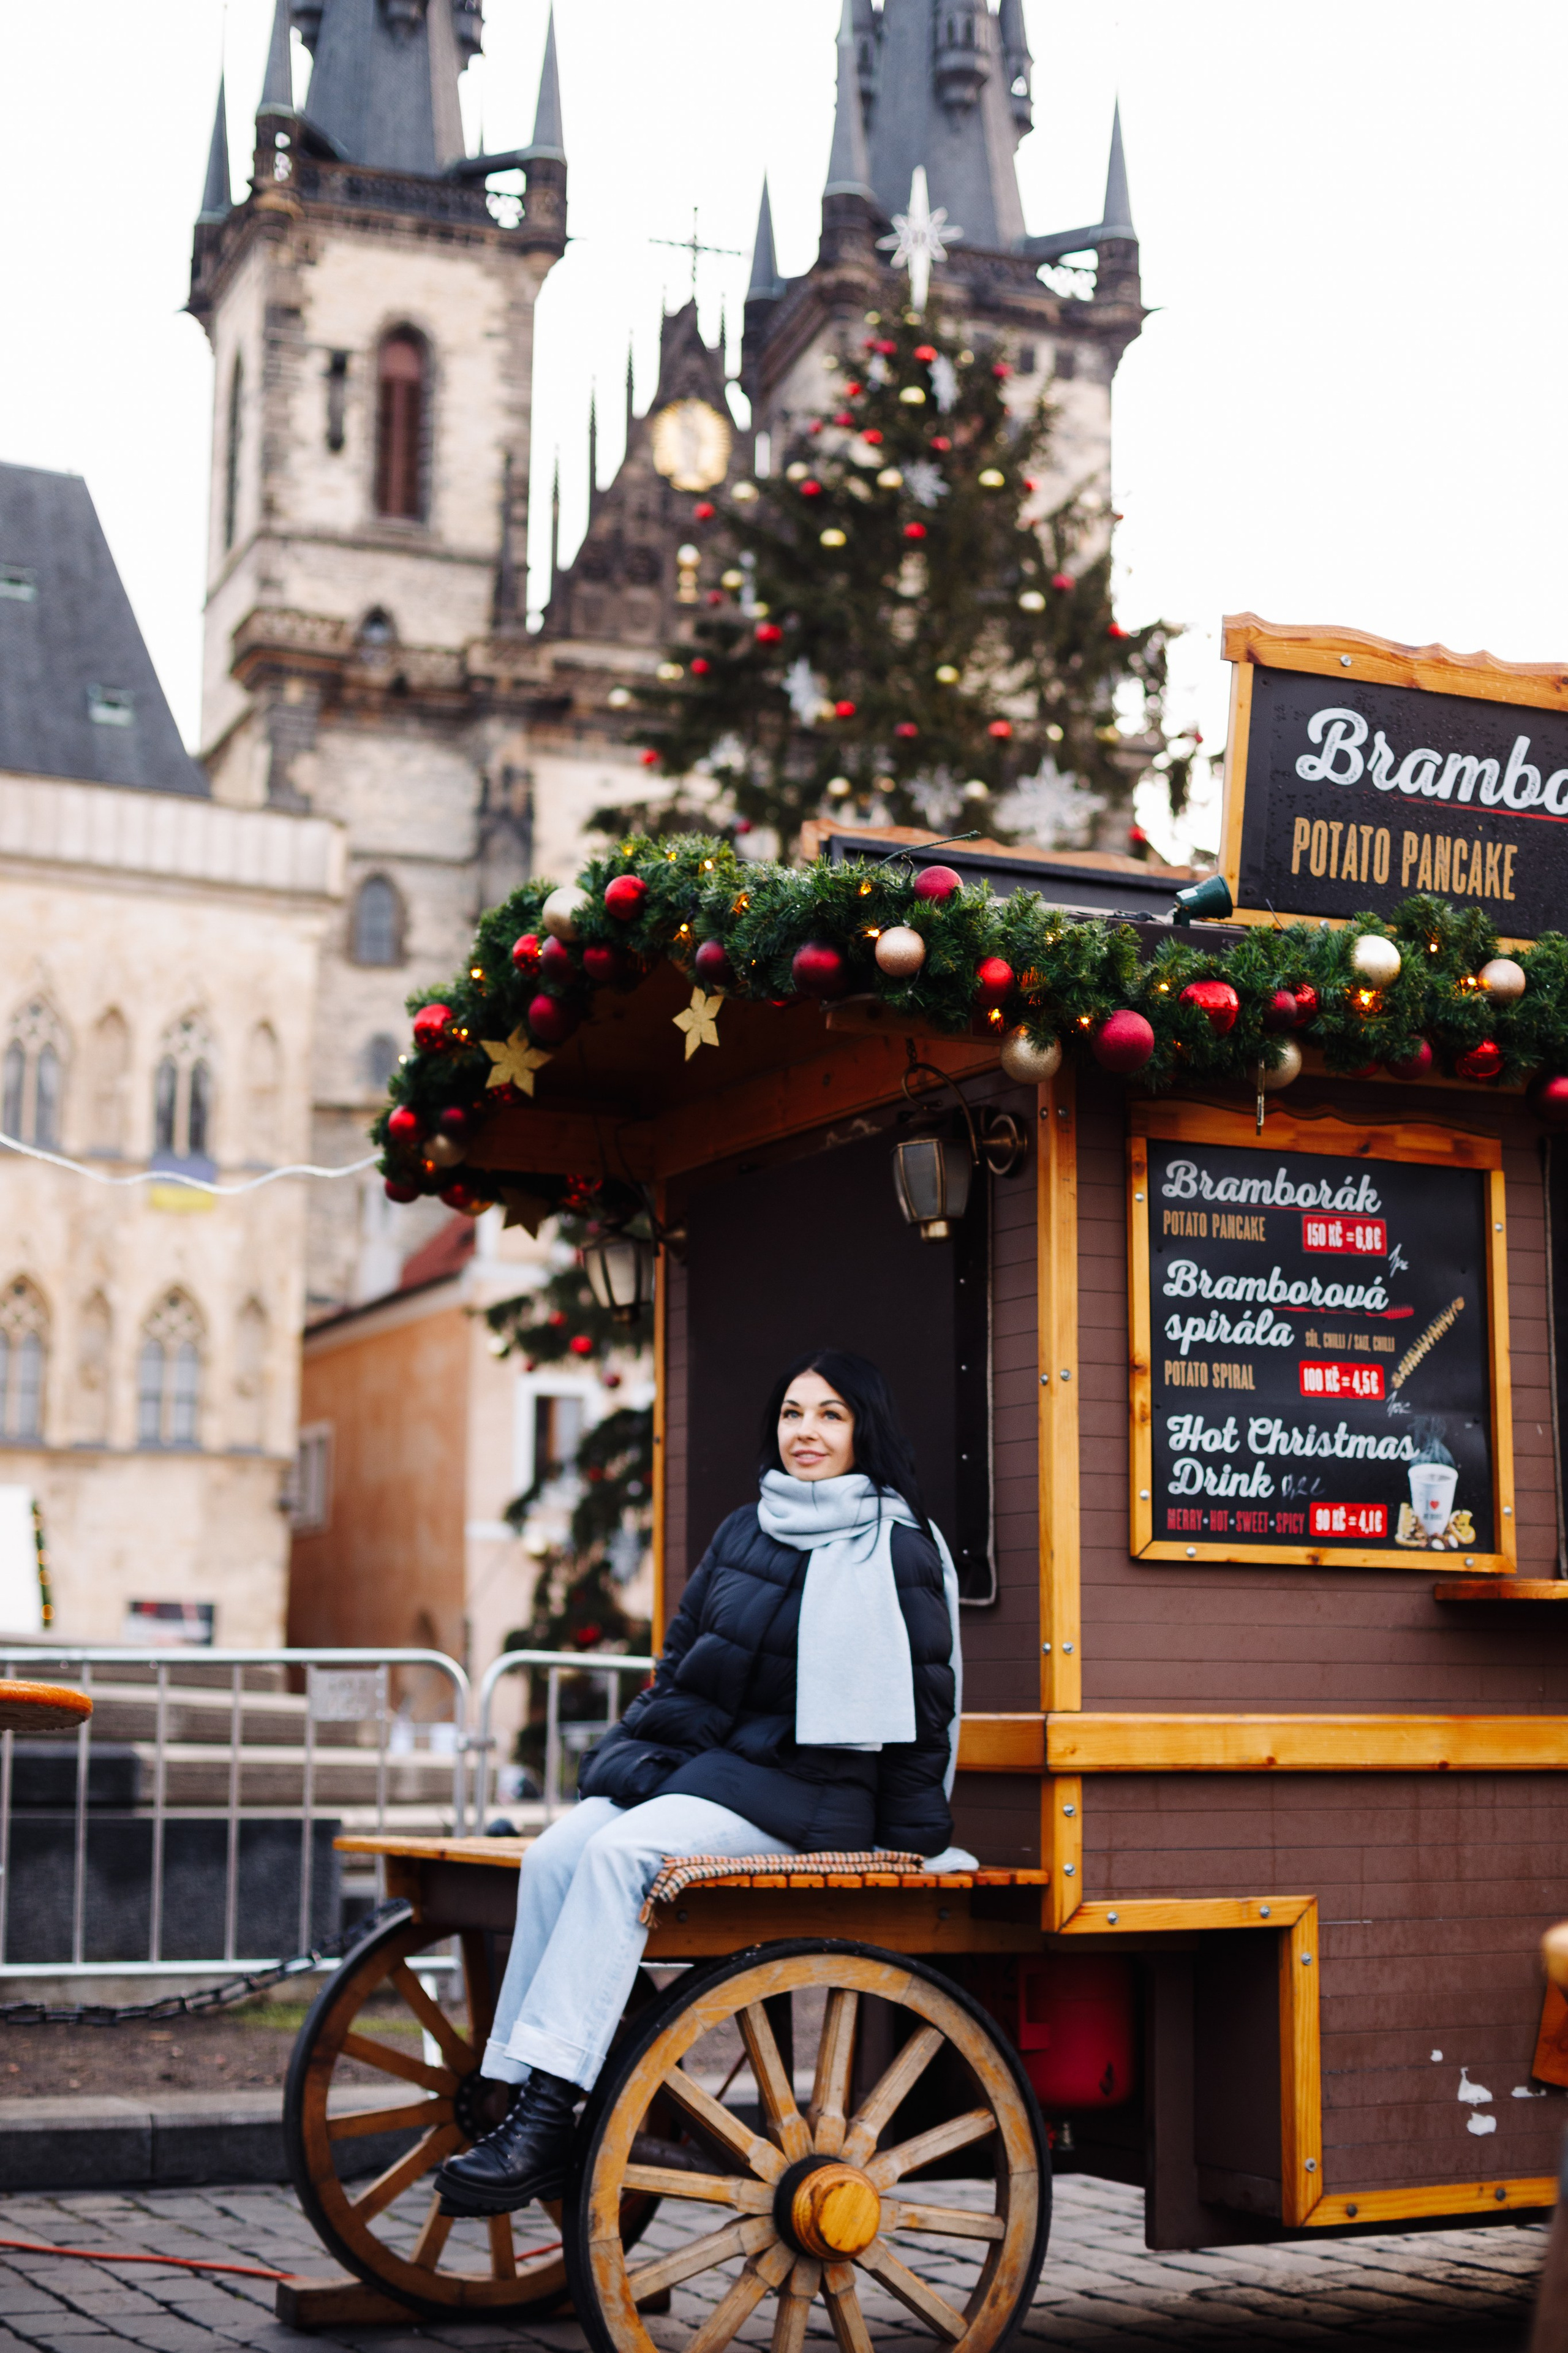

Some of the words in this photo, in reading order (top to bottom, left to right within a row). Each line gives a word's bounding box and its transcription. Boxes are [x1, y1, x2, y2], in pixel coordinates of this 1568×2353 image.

[1291, 817, 1390, 885] POTATO
[1401, 831, 1518, 901] PANCAKE
[1162, 1160, 1382, 1214] Bramborák
[1163, 1210, 1207, 1237] POTATO
[1212, 1214, 1266, 1242] PANCAKE
[1307, 1222, 1327, 1247] 150
[1163, 1260, 1389, 1310] Bramborová
[1164, 1309, 1295, 1356] spirála
[1164, 1359, 1208, 1387] POTATO
[1212, 1362, 1256, 1390] SPIRAL
[1166, 1414, 1240, 1453] Hot
[1247, 1417, 1420, 1461] Christmas
[1167, 1457, 1275, 1498] Drink
